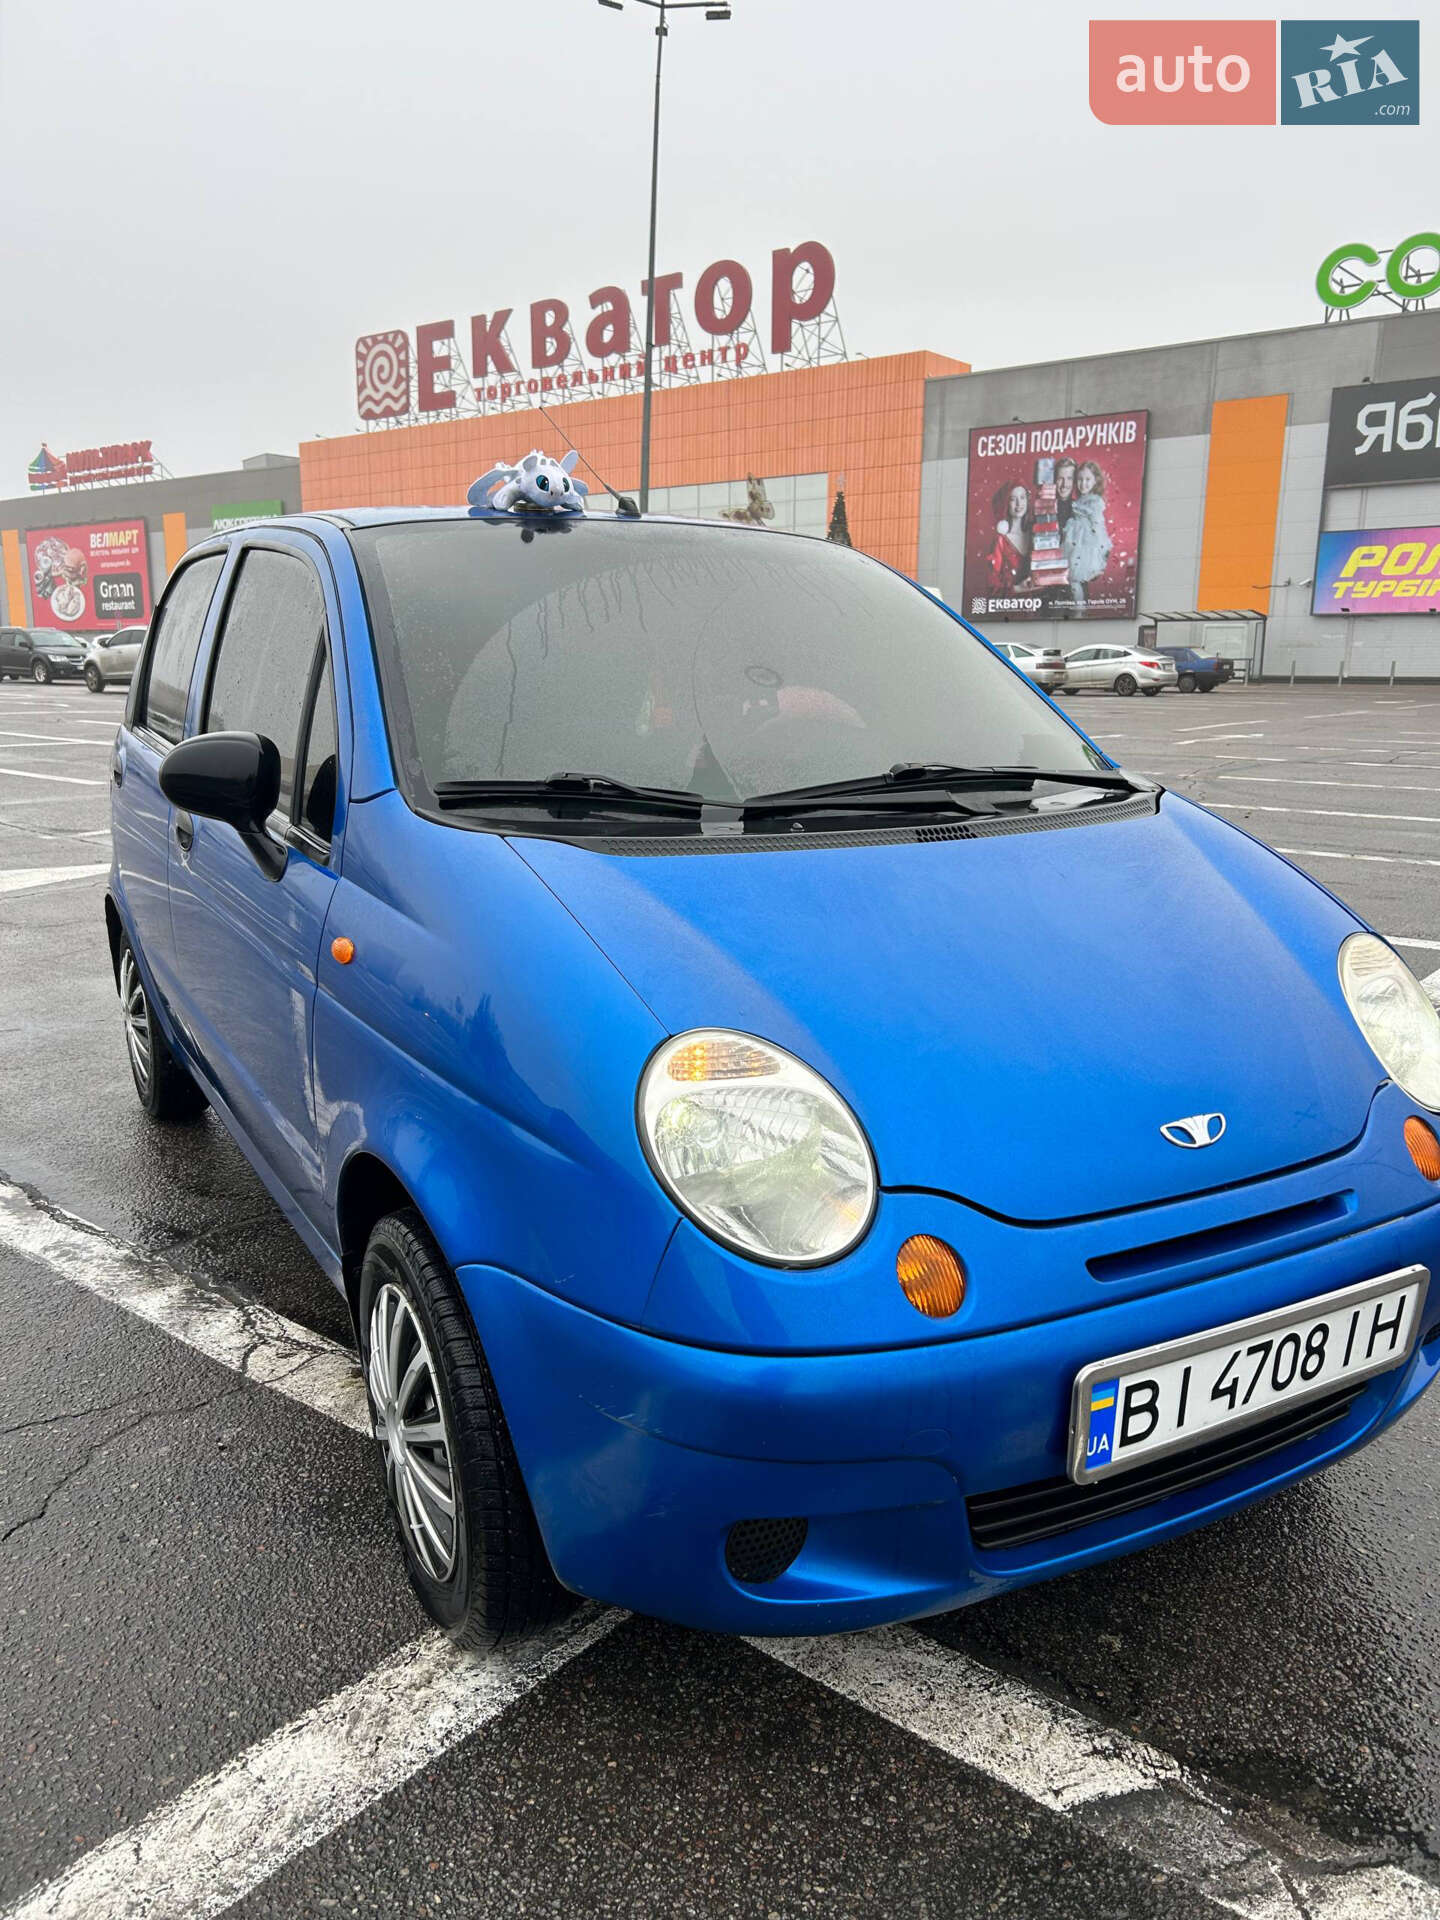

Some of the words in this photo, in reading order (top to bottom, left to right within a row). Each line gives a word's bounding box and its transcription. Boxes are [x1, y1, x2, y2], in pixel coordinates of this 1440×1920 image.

[663, 342, 749, 374] центр
[977, 432, 1027, 457] СЕЗОН
[1030, 421, 1137, 454] ПОДАРУНКІВ
[1354, 392, 1440, 456] Яб
[90, 529, 138, 548] ВЕЛМАРТ
[102, 600, 135, 611] restaurant
[1118, 1365, 1192, 1448] BI
[1210, 1322, 1330, 1411] 4708
[1086, 1434, 1110, 1457] UA
